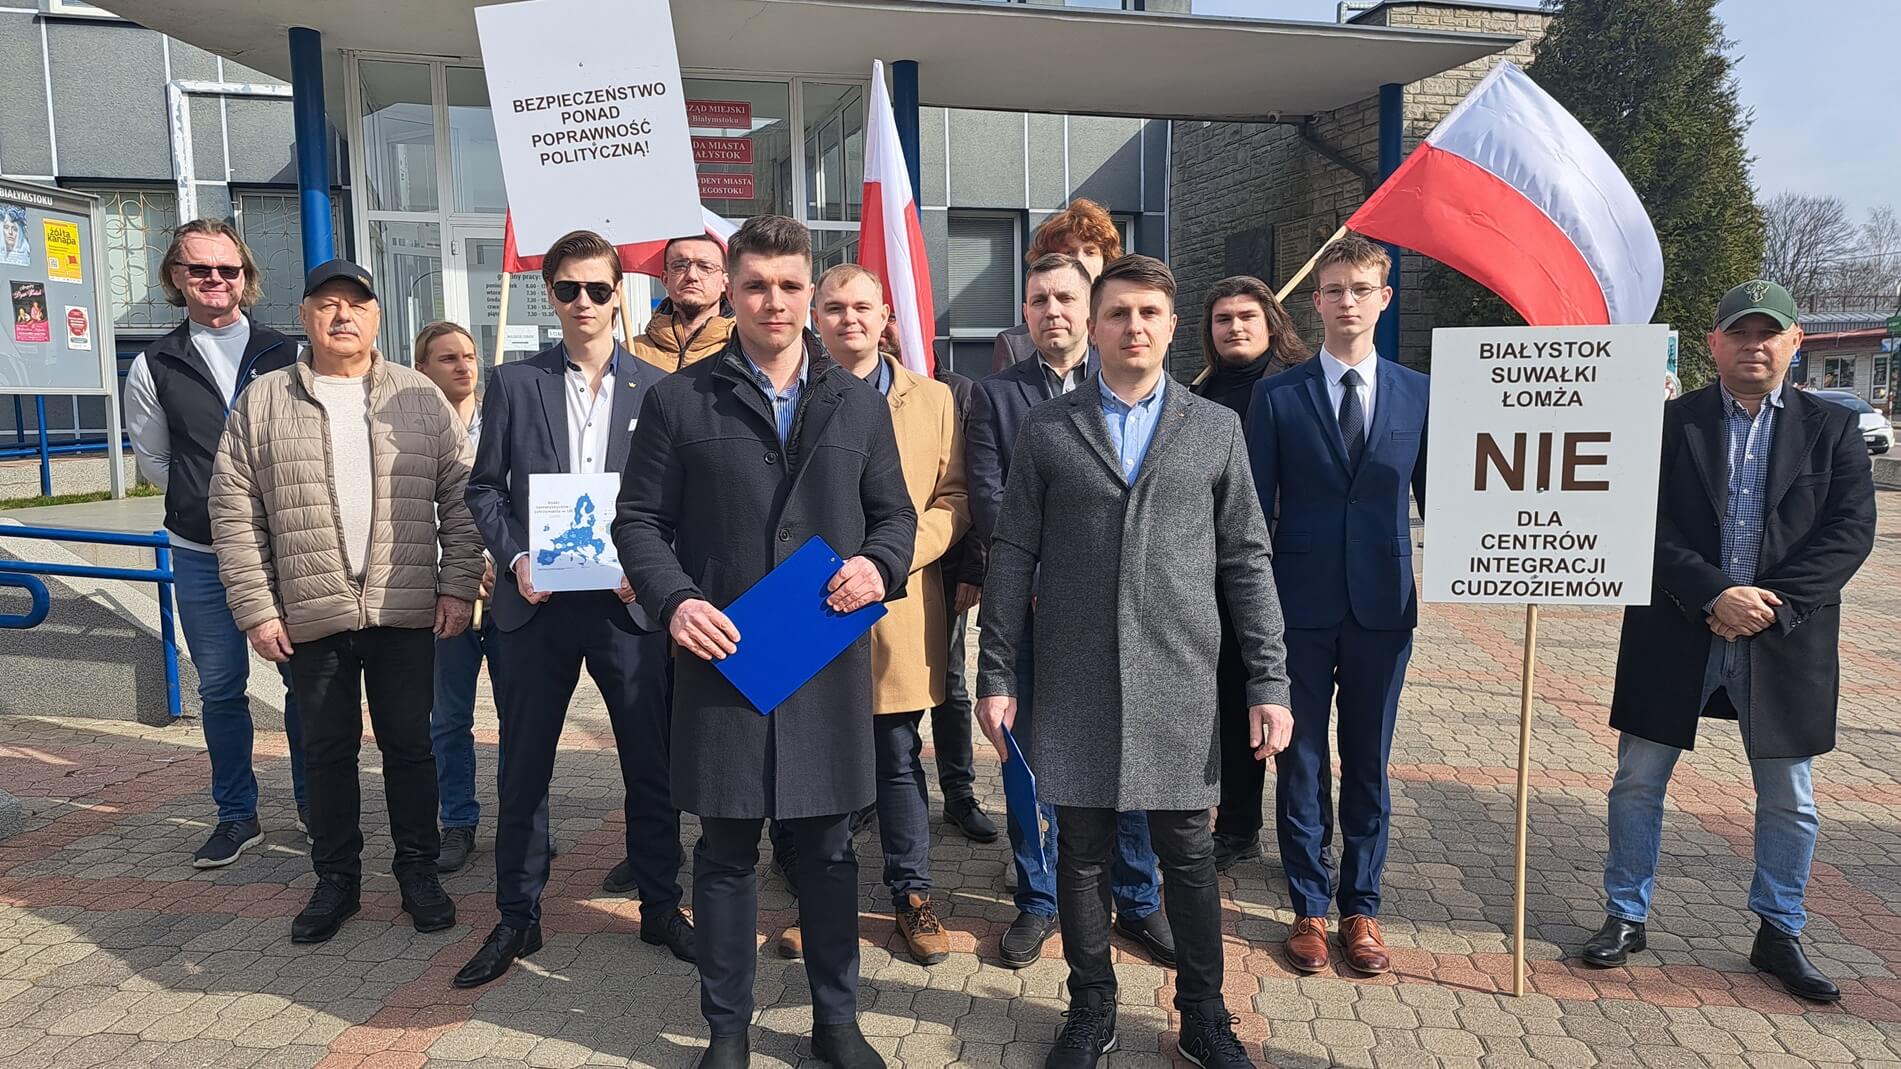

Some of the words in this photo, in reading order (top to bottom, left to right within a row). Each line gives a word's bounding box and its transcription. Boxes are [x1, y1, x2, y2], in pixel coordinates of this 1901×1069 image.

[512, 81, 666, 113] BEZPIECZEŃSTWO
[561, 105, 620, 125] PONAD
[688, 104, 707, 113] ZĄD
[709, 105, 745, 114] MIEJSKI
[531, 118, 652, 148] POPRAWNOŚĆ
[540, 140, 650, 166] POLITYCZNĄ!
[692, 141, 706, 149] DA
[708, 141, 746, 150] MIASTA
[695, 151, 741, 159] AŁYSTOK
[0, 187, 53, 206] BIAŁYMSTOKU
[1479, 341, 1612, 360] BIAŁYSTOK
[1491, 365, 1597, 383] SUWAŁKI
[1501, 386, 1584, 407] ŁOMŻA
[1474, 432, 1611, 491] NIE
[1517, 510, 1563, 527] DLA
[1480, 530, 1598, 550] CENTRÓW
[1469, 557, 1606, 574] INTEGRACJI
[1450, 577, 1624, 598] CUDZOZIEMÓW
